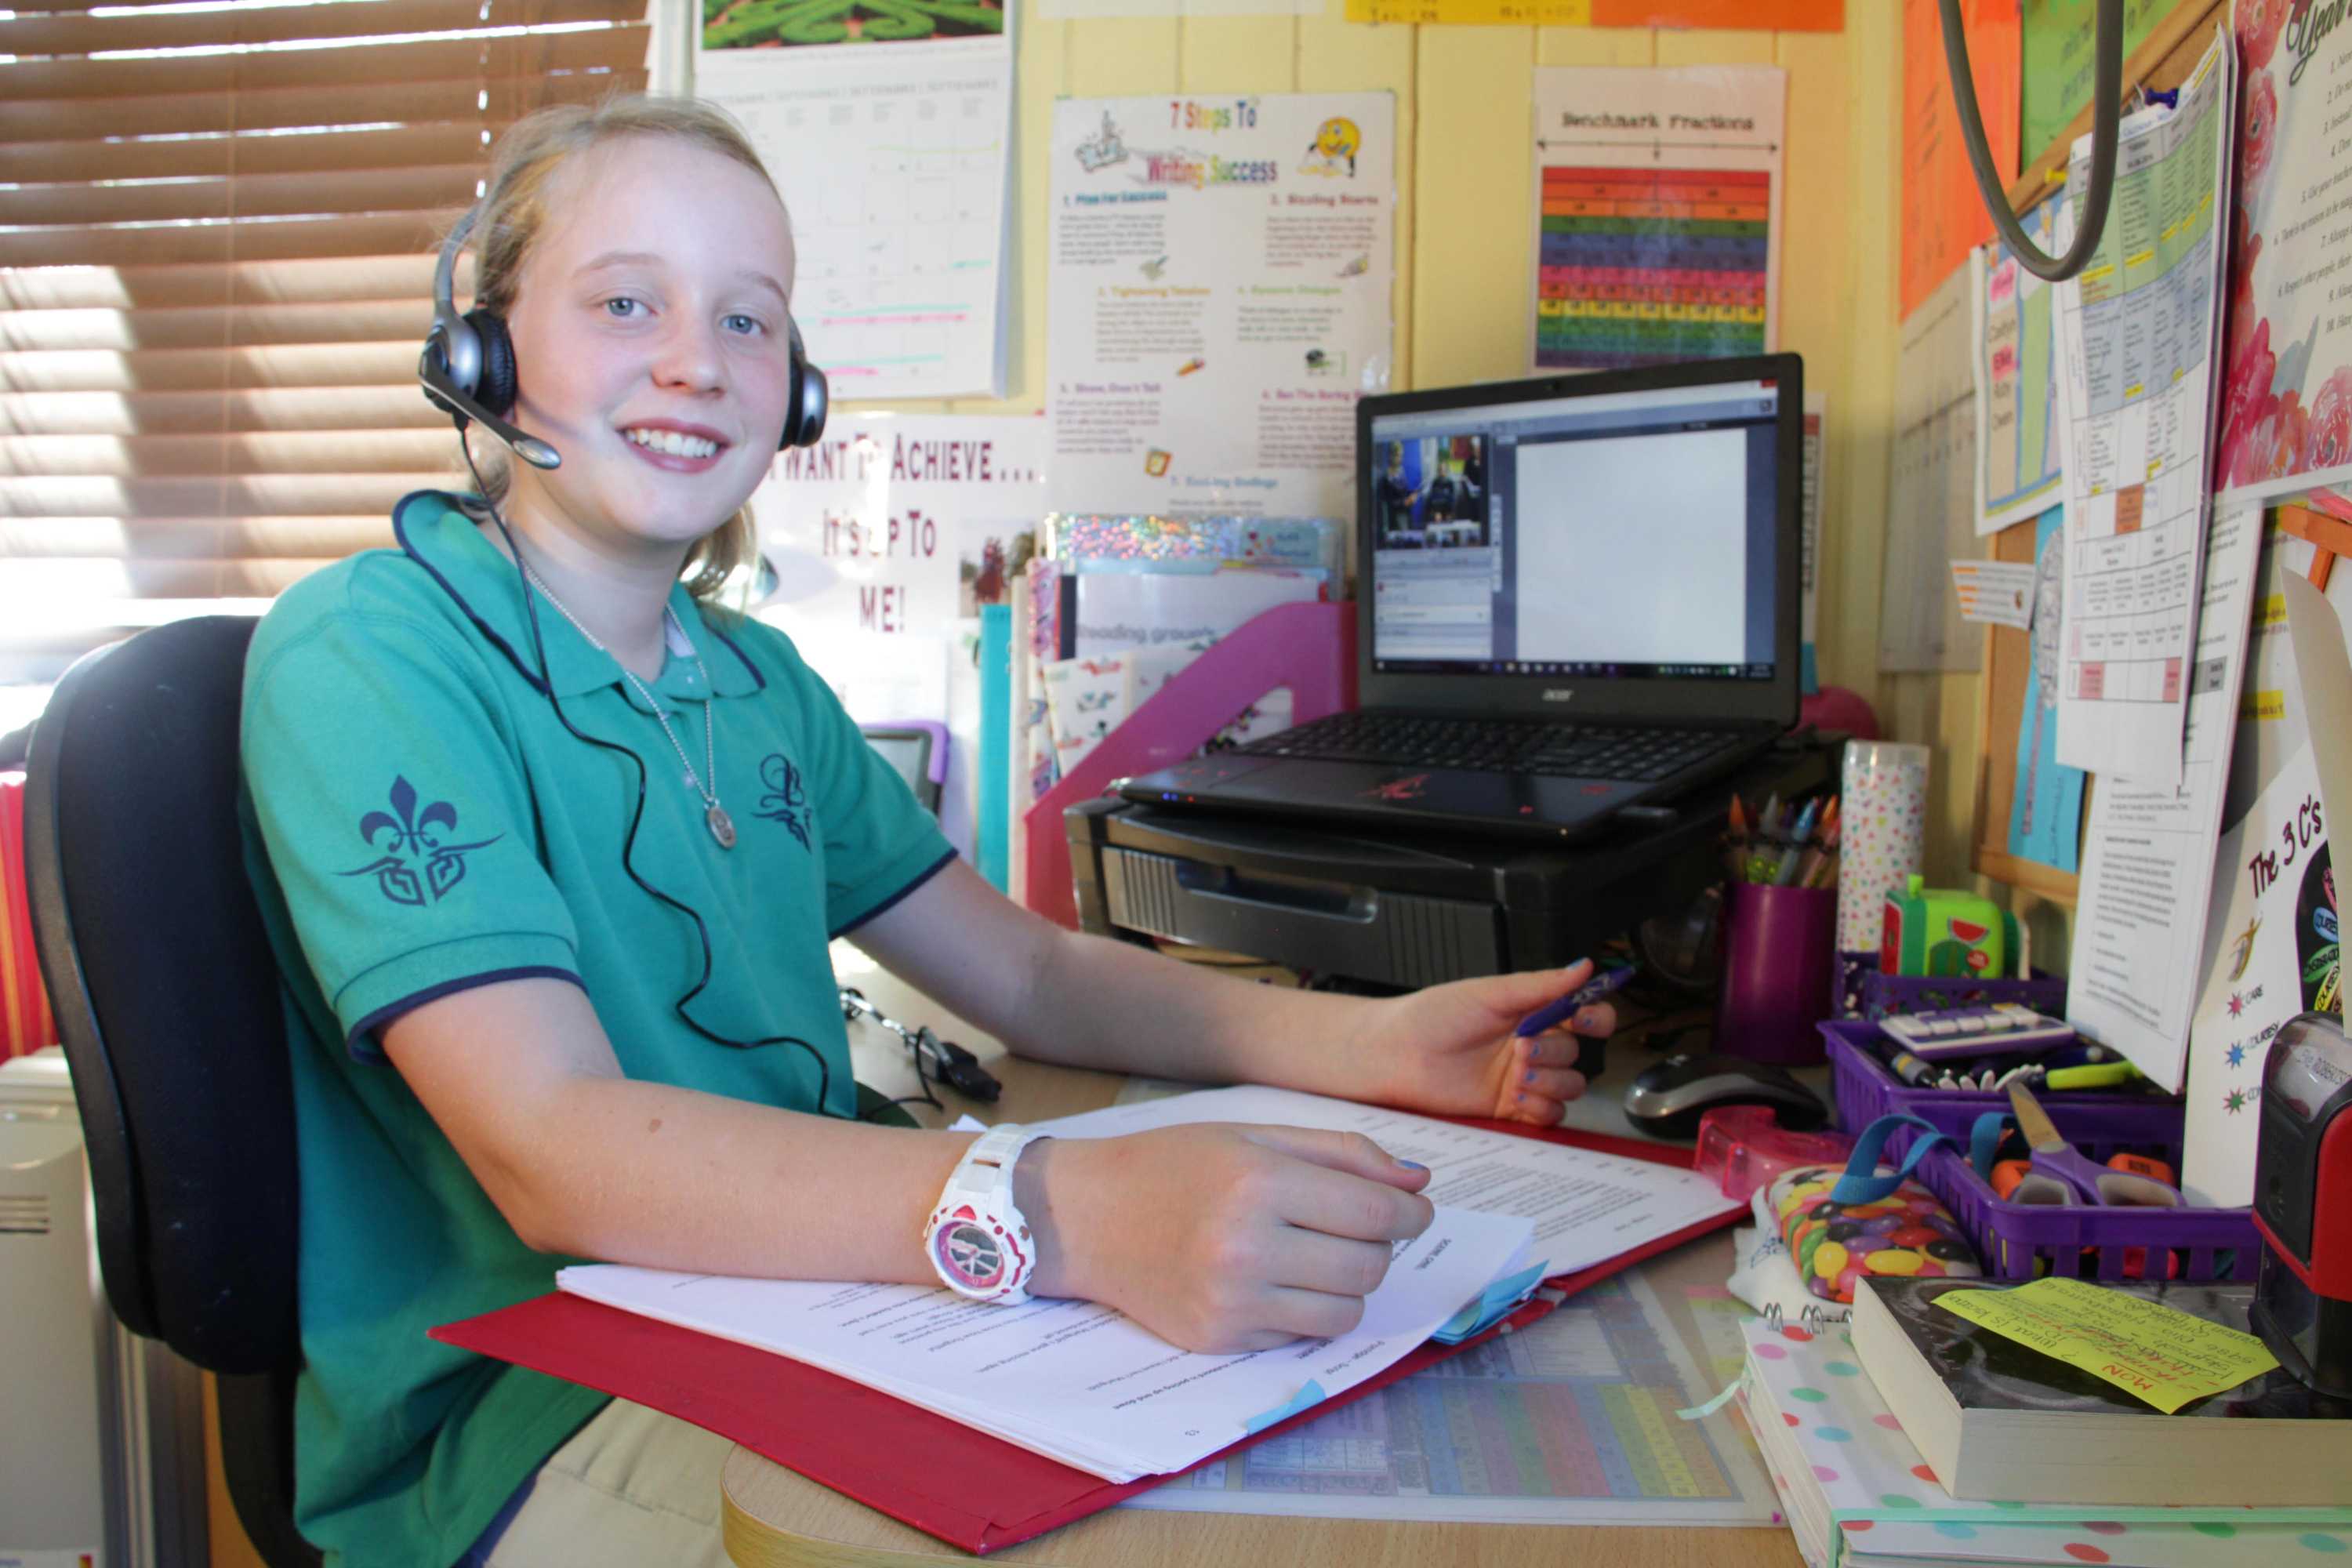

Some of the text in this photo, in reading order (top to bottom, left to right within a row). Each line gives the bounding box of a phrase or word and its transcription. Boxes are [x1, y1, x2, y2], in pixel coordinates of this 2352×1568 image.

[1171, 101, 1257, 134] 7 Steps To
[1562, 111, 1754, 131] Benchmark Fractions
[1145, 156, 1278, 190] Writing Success
[1122, 190, 1167, 203] Success
[860, 585, 906, 632] ME!
[1542, 688, 1573, 702] acer
[2249, 793, 2322, 899] The 3 C's
[1994, 1316, 2009, 1330] is
[2014, 1325, 2058, 1349] What
[2101, 1363, 2154, 1392] MON
